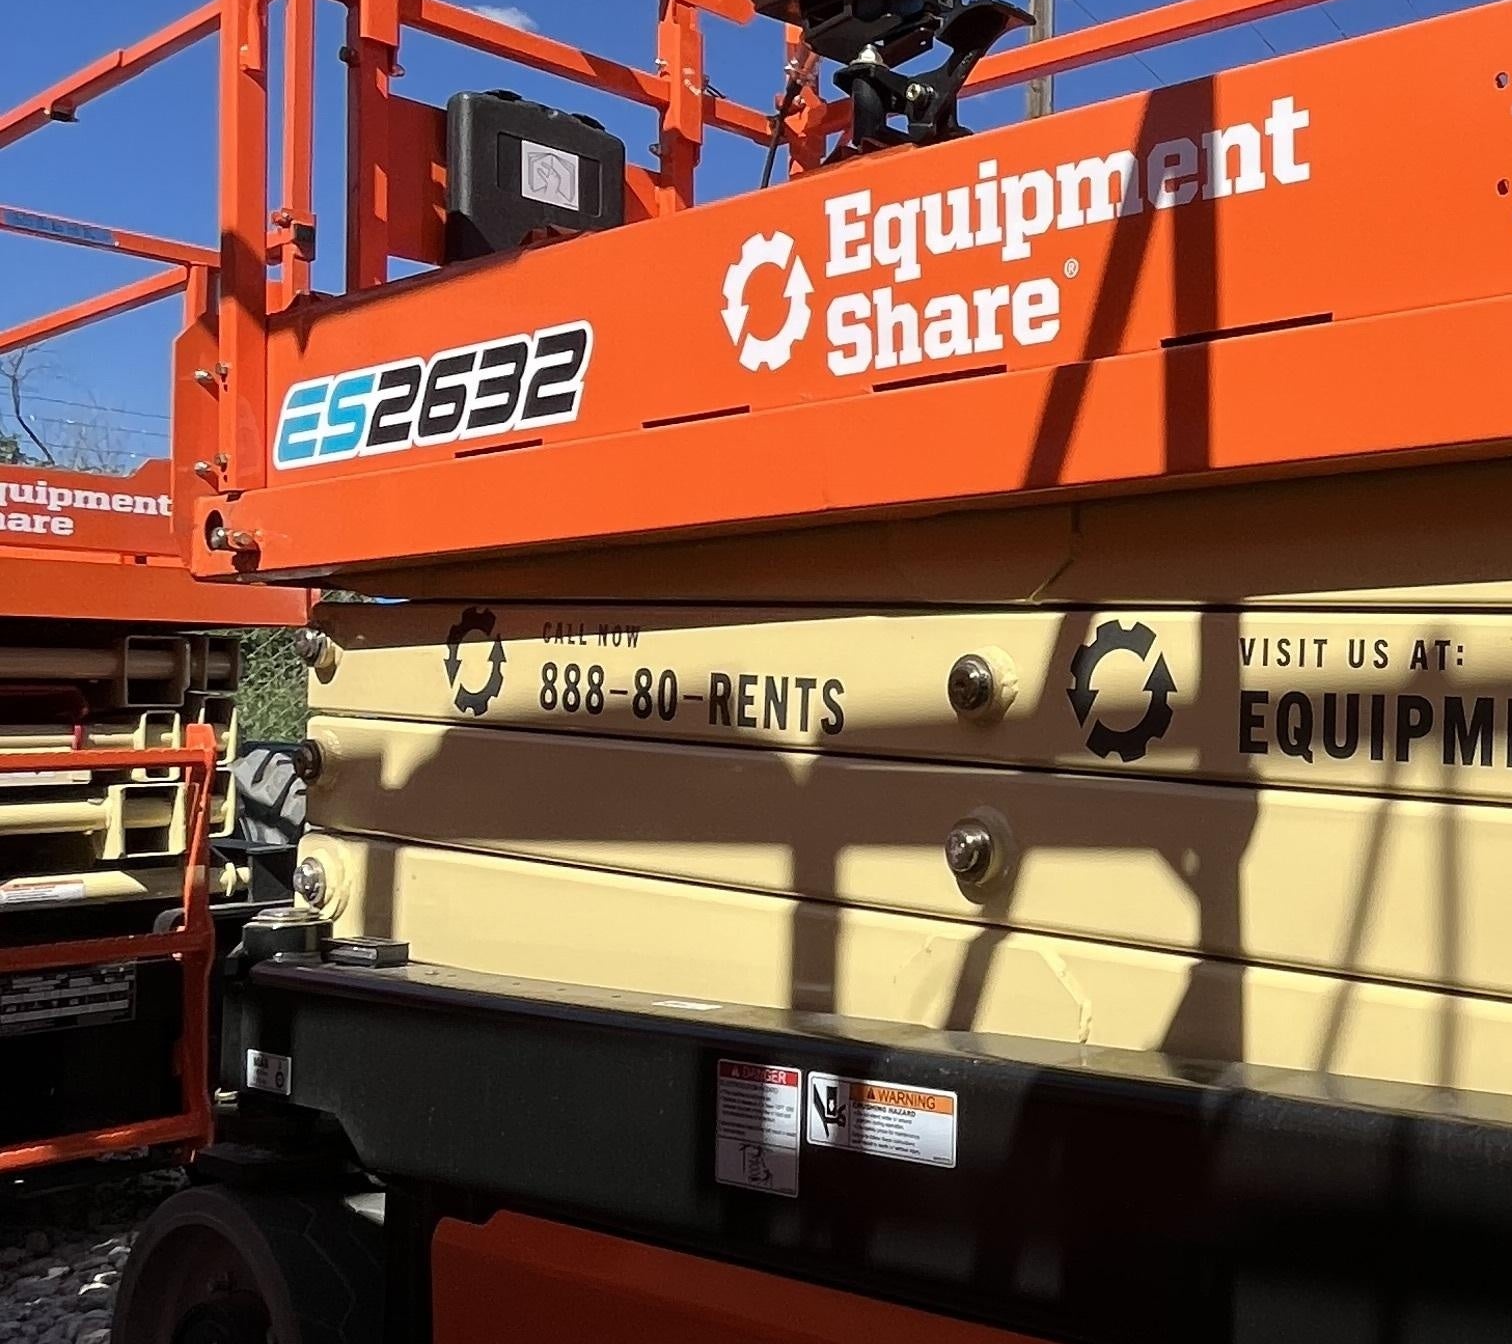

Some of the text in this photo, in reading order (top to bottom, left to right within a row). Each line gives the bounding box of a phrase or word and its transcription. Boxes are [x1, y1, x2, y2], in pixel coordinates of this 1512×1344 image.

[824, 96, 1311, 280] Equipment
[826, 278, 1061, 377] Share
[276, 320, 592, 470] ES2632
[542, 621, 641, 649] CALL NOW
[1239, 637, 1465, 672] VISIT US AT:
[743, 1064, 787, 1085] DANGER
[878, 1089, 936, 1110] WARNING
[888, 1107, 916, 1118] HAZARD
